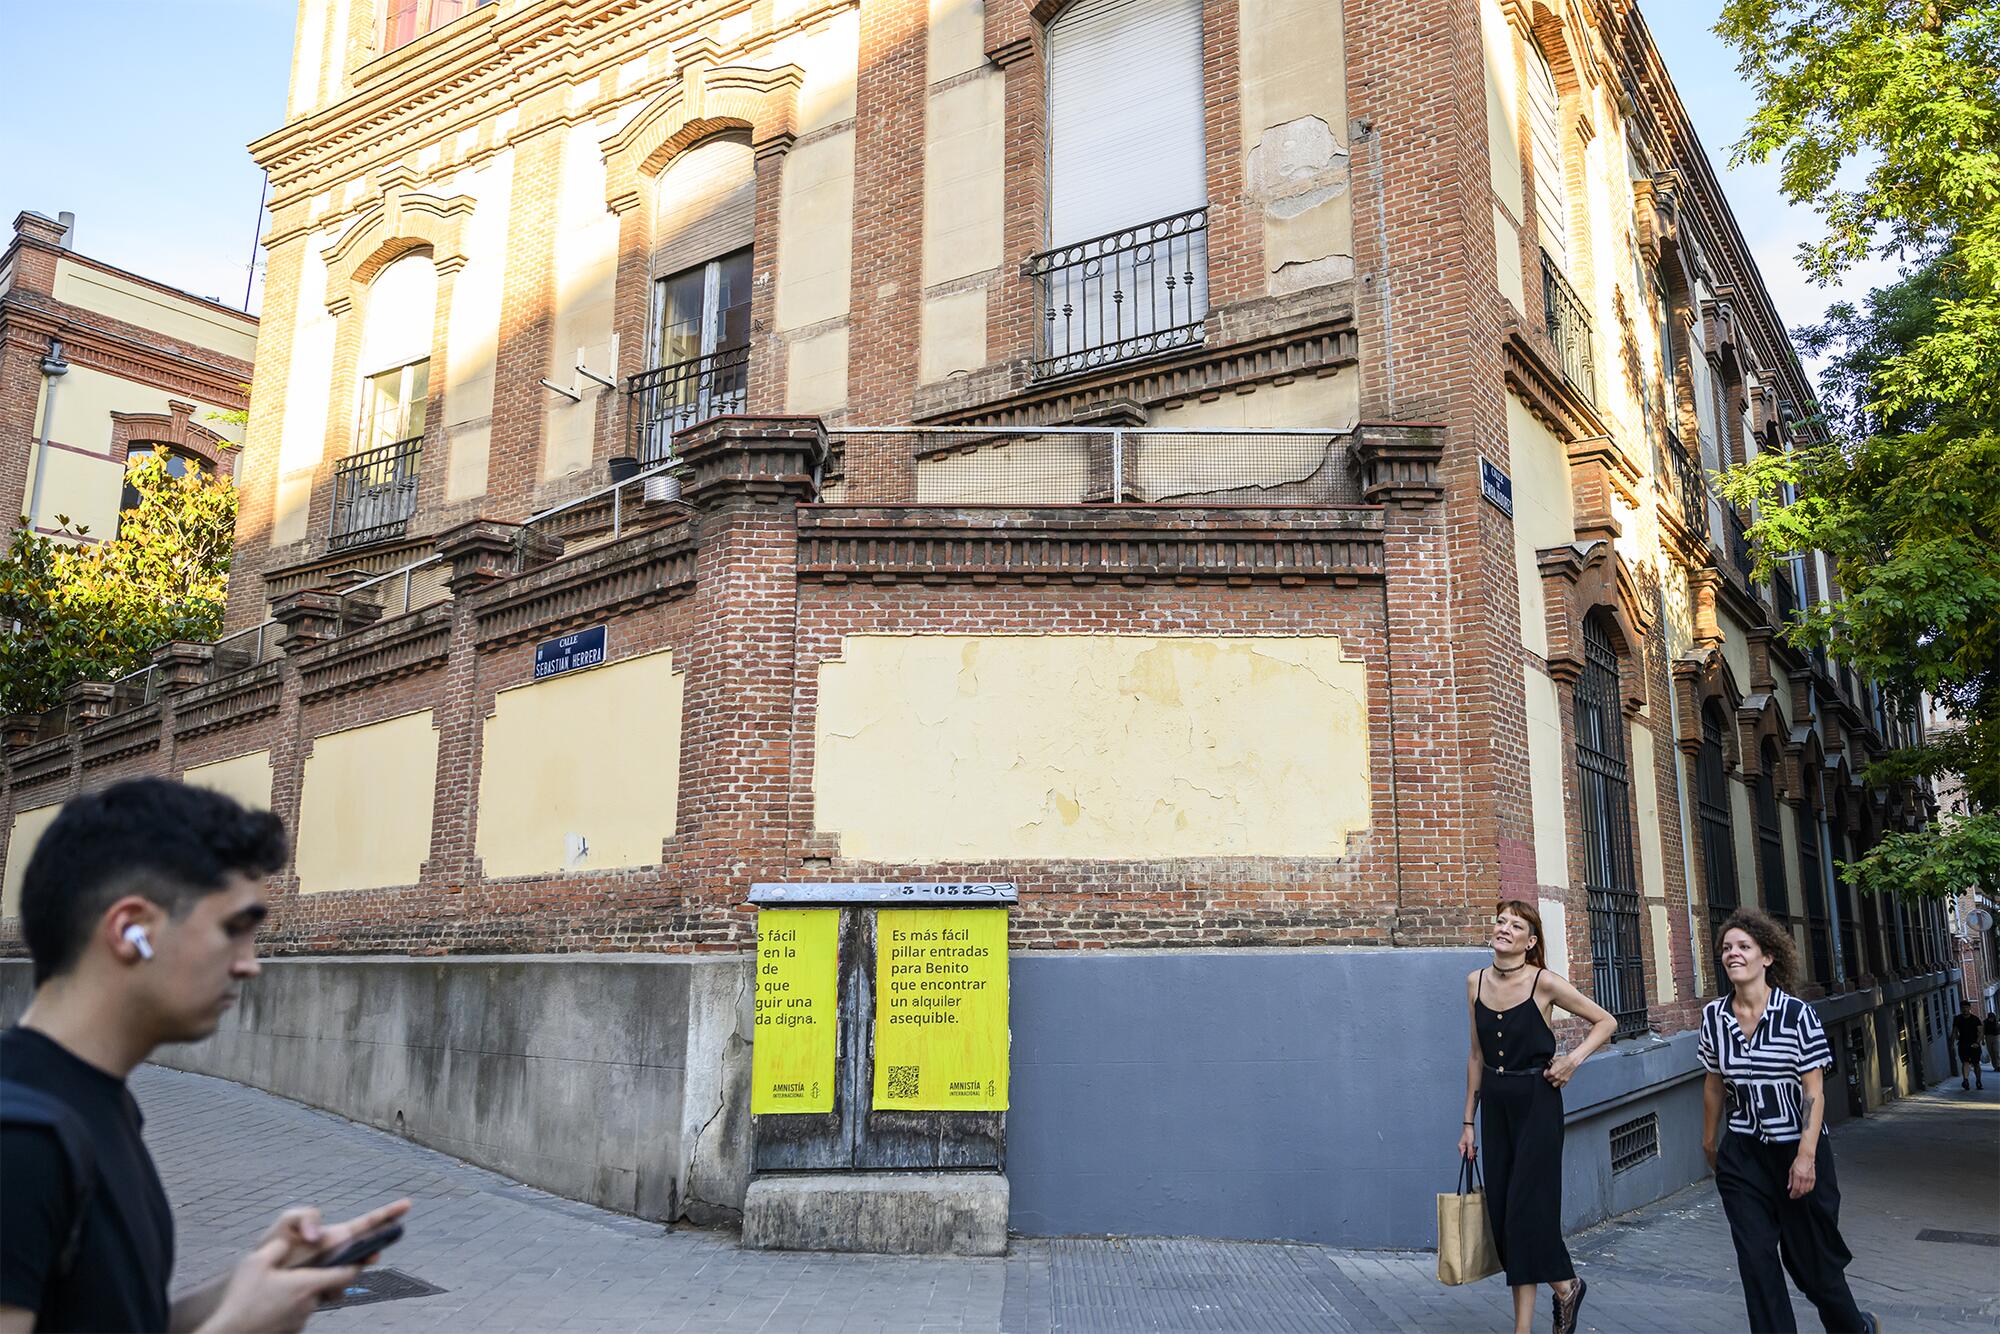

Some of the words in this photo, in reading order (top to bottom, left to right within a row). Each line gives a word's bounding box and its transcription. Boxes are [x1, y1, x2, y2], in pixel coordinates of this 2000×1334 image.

[560, 635, 578, 647] CALLE
[536, 656, 569, 676] SEBASTIAN
[572, 648, 601, 667] HERRERA
[768, 930, 796, 941] fácil
[892, 930, 906, 941] Es
[910, 929, 938, 941] más
[942, 929, 969, 940] fácil
[763, 949, 780, 958] en
[784, 946, 796, 958] la
[892, 946, 926, 960] pillar
[929, 945, 989, 957] entradas
[762, 963, 779, 975] de
[891, 964, 921, 977] para
[926, 962, 969, 973] Benito
[764, 982, 790, 994] que
[890, 981, 916, 993] que
[920, 980, 986, 990] encontrar
[787, 998, 812, 1008] una
[890, 998, 907, 1007] un
[912, 995, 962, 1010] alquiler
[775, 1013, 817, 1028] digna.
[890, 1012, 959, 1027] asequible.
